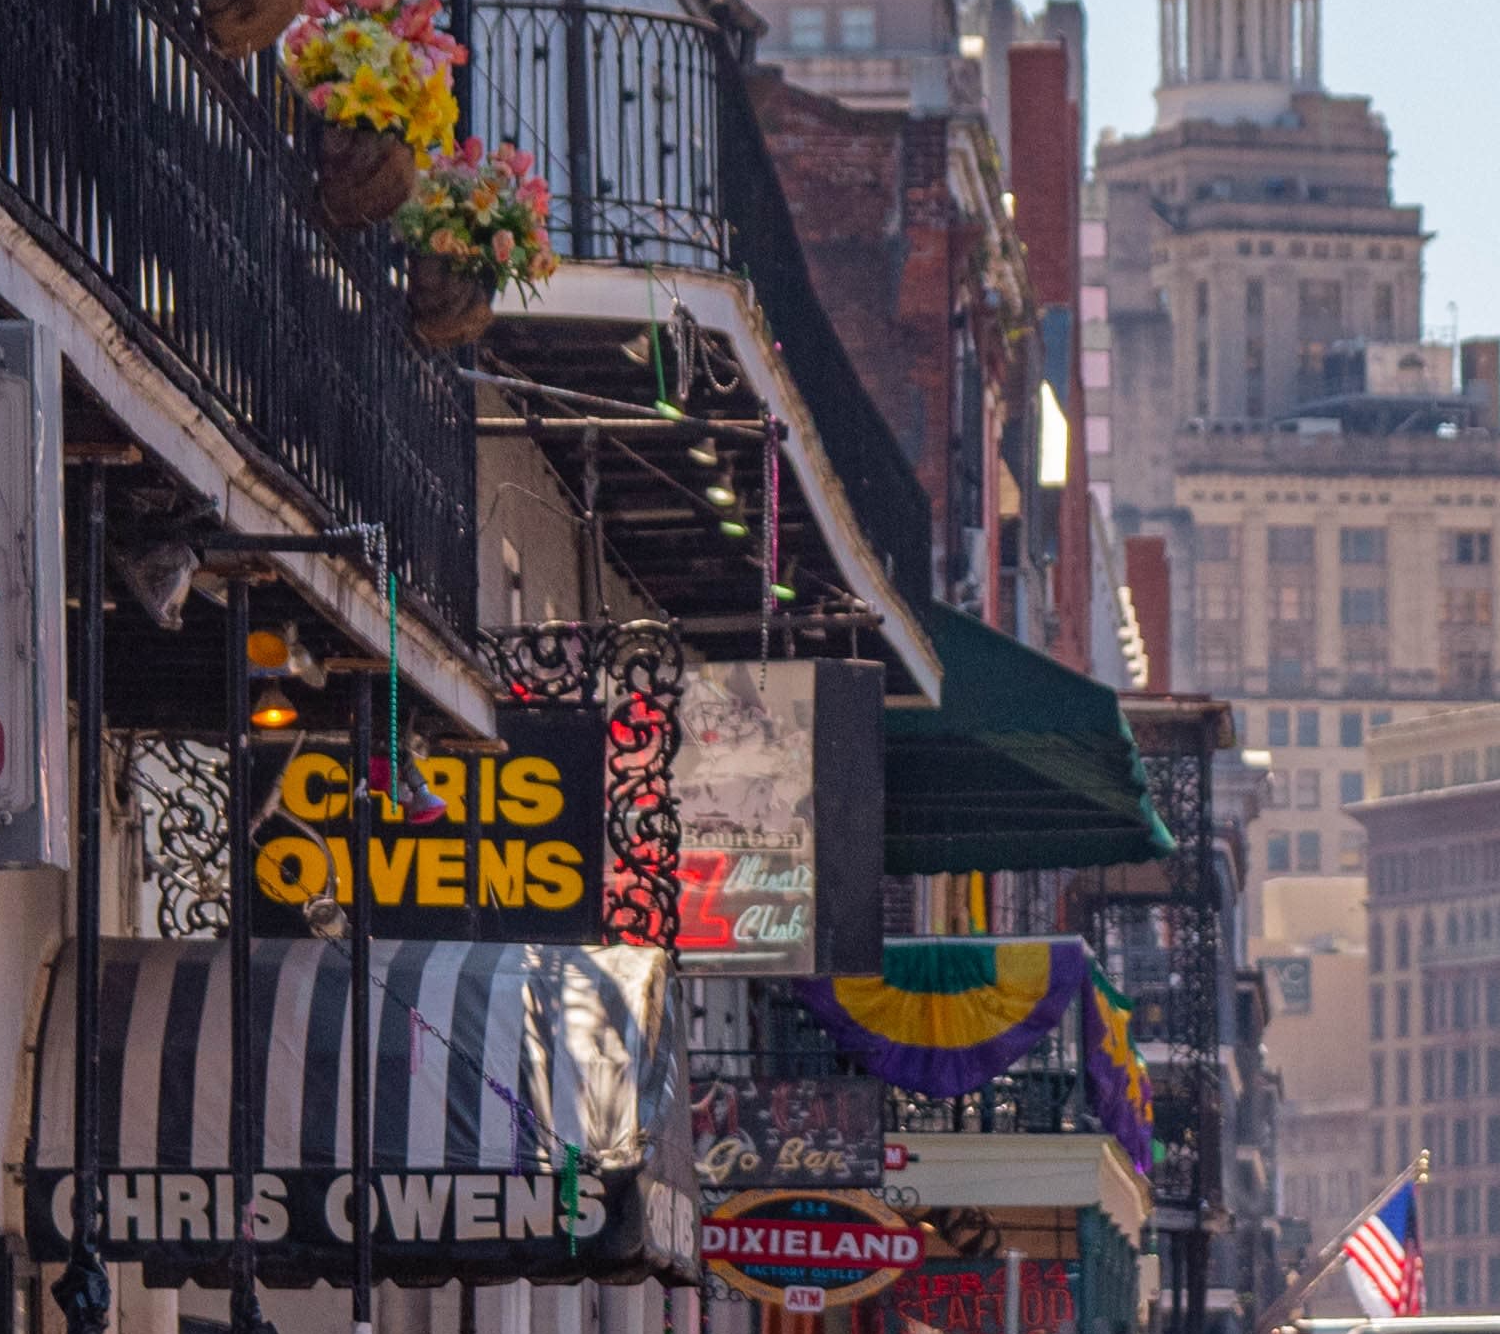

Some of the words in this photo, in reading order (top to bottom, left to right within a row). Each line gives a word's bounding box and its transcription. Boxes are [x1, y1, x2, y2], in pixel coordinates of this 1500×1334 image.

[256, 837, 584, 911] OWENS
[324, 1172, 607, 1242] OWENS
[701, 1224, 920, 1263] DIXIELAND
[788, 1289, 821, 1307] ATM
